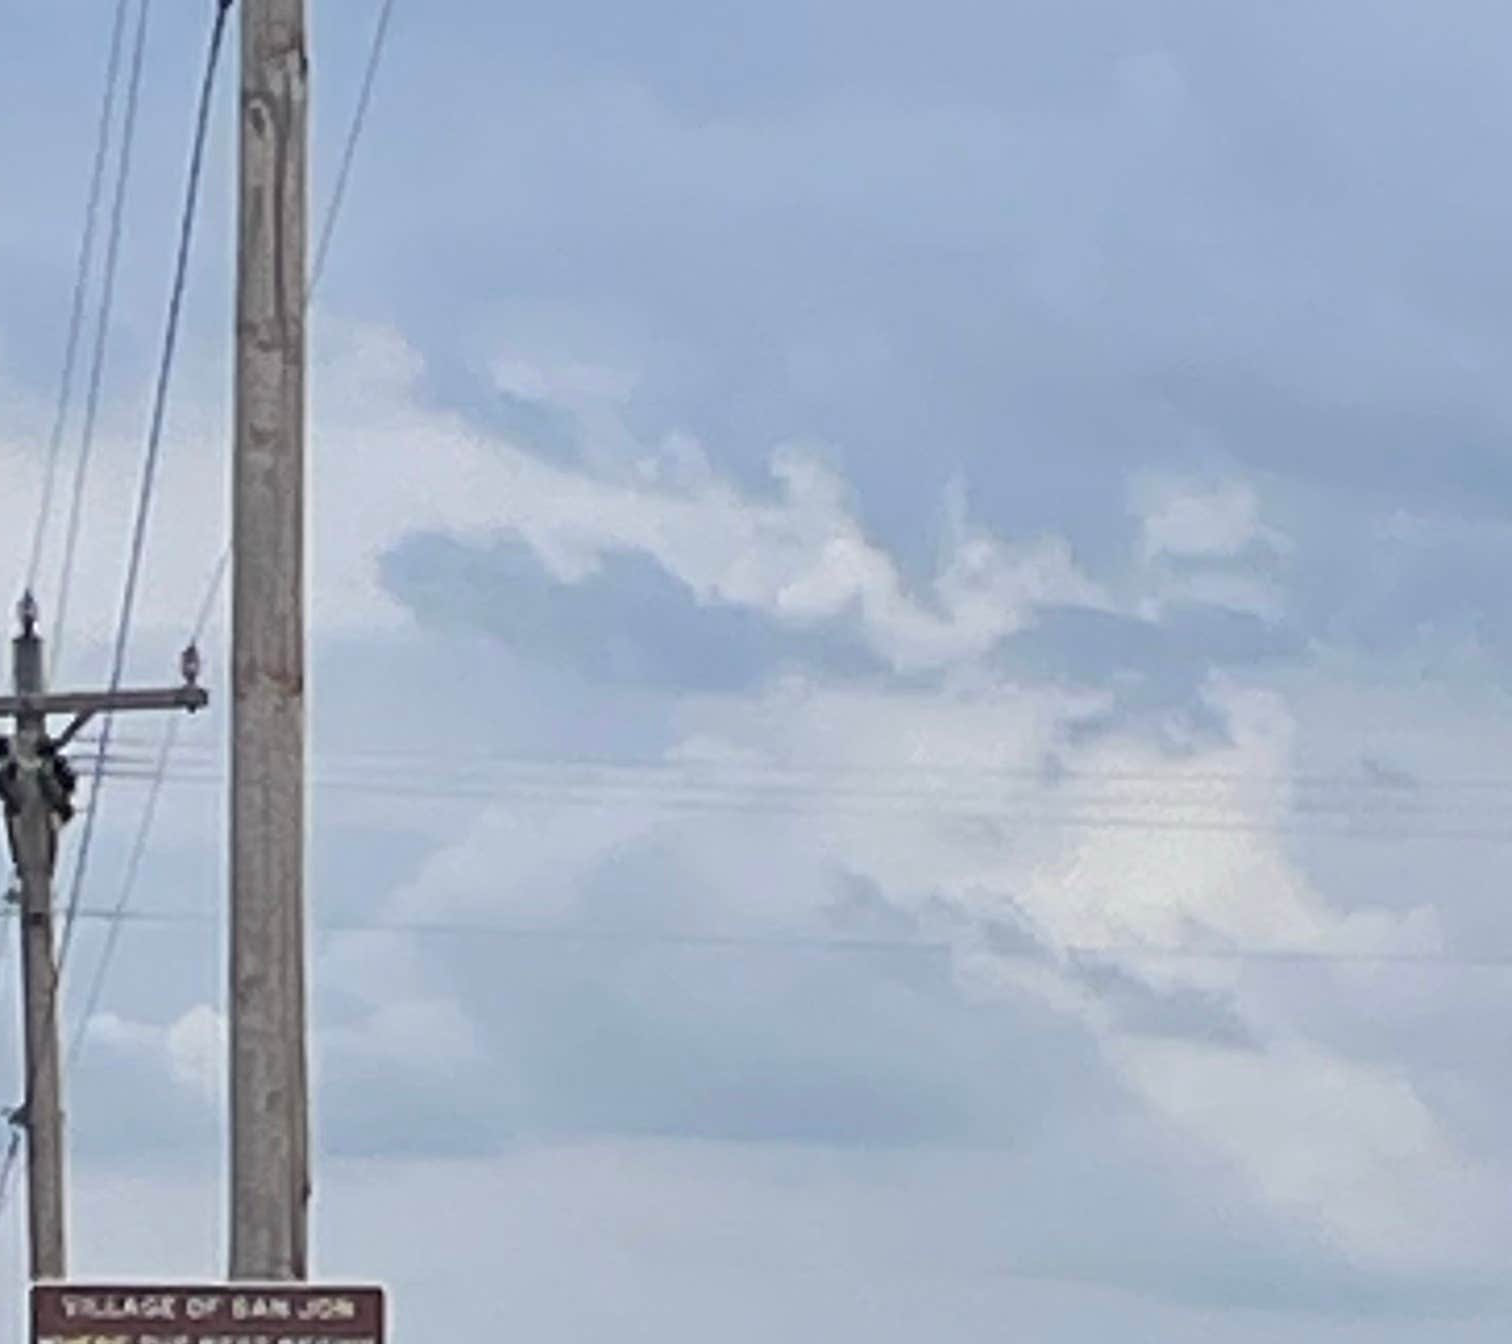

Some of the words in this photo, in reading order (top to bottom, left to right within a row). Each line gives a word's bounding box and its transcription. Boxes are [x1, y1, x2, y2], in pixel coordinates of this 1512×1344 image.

[186, 1295, 219, 1321] OF
[232, 1295, 290, 1321] SAN
[297, 1296, 355, 1321] JON
